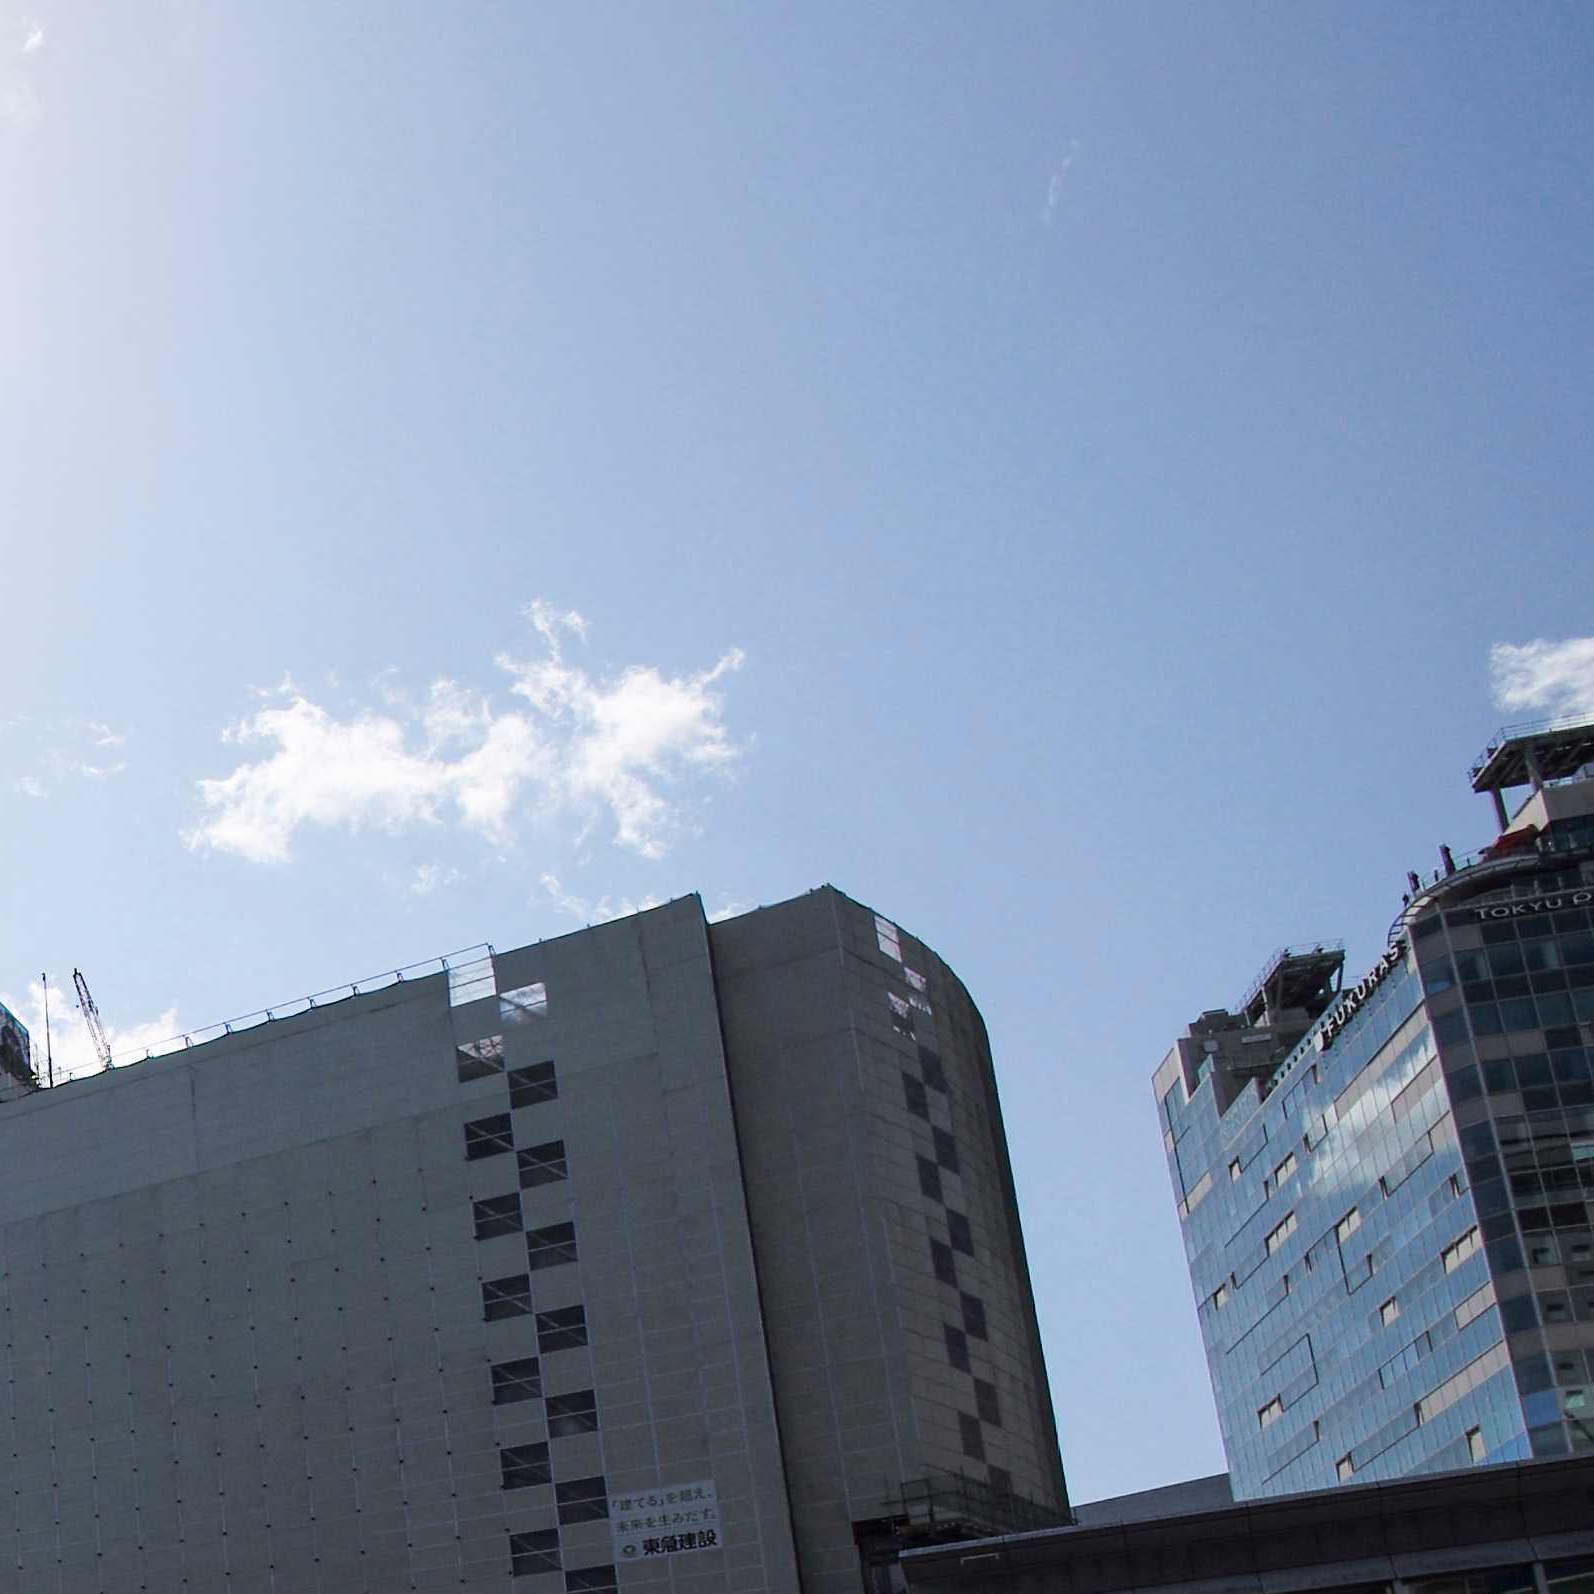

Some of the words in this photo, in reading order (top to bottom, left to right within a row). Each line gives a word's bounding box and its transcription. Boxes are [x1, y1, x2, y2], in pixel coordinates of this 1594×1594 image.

[1476, 897, 1562, 920] TOKYU
[1324, 943, 1400, 1037] FUKURAS
[641, 1529, 717, 1555] 東急建設
